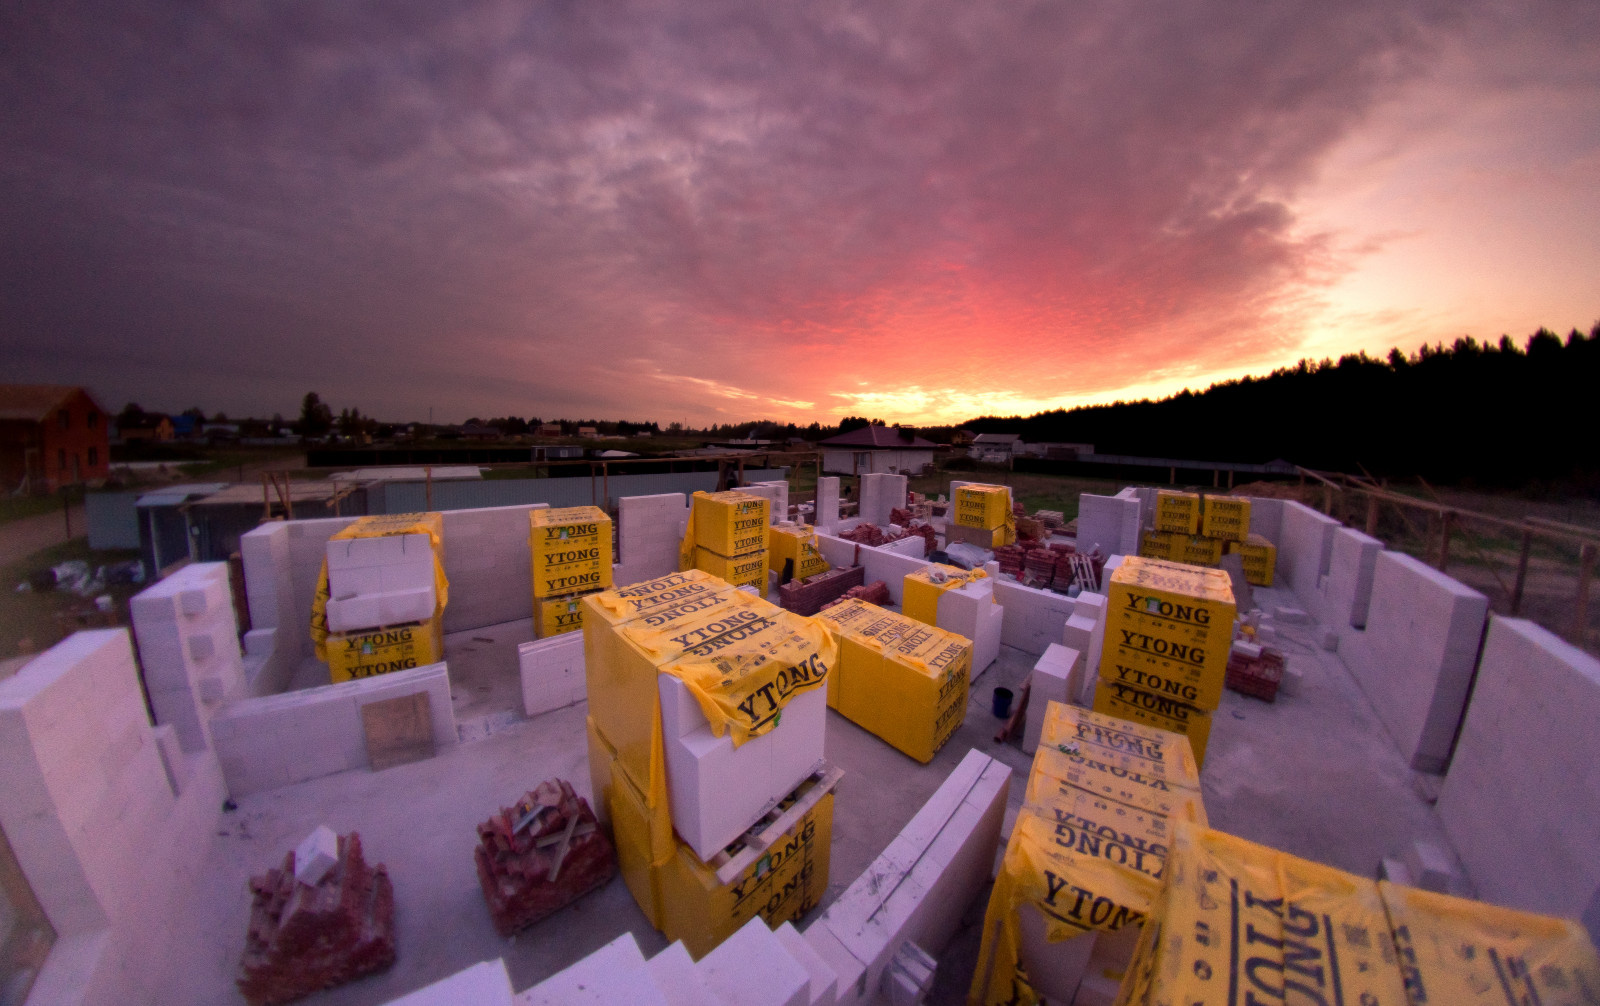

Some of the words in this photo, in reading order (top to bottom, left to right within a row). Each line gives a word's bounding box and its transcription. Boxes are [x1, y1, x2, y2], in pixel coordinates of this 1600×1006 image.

[734, 517, 763, 530] YTONG
[734, 535, 763, 549] YTONG
[544, 547, 600, 565] YTONG
[734, 560, 763, 574] YTONG
[546, 571, 601, 590] YTONG
[627, 583, 706, 610] YTONG
[644, 593, 728, 626] YTONG
[1126, 592, 1211, 625] YONG
[670, 610, 759, 648] YTONG
[898, 630, 934, 655] YTONG
[928, 642, 964, 669] YTONG
[1120, 628, 1206, 664] YTONG
[345, 657, 418, 679] YTONG
[738, 653, 828, 724] YTONG
[1115, 664, 1198, 701] YTONG
